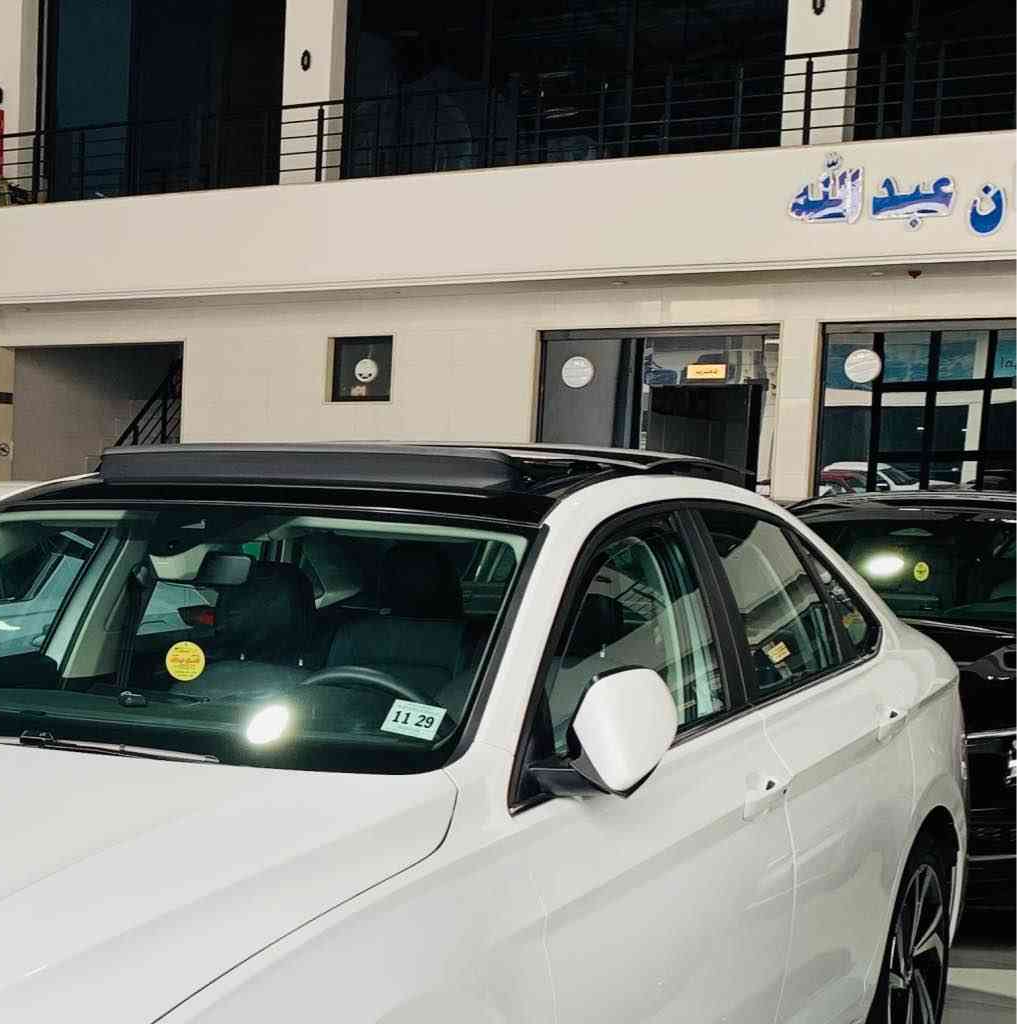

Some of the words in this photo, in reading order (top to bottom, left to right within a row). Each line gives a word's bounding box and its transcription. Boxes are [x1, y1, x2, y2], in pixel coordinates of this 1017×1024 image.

[789, 152, 864, 223] الله
[871, 176, 955, 231] عبد
[392, 710, 411, 725] 11
[414, 714, 435, 729] 29
